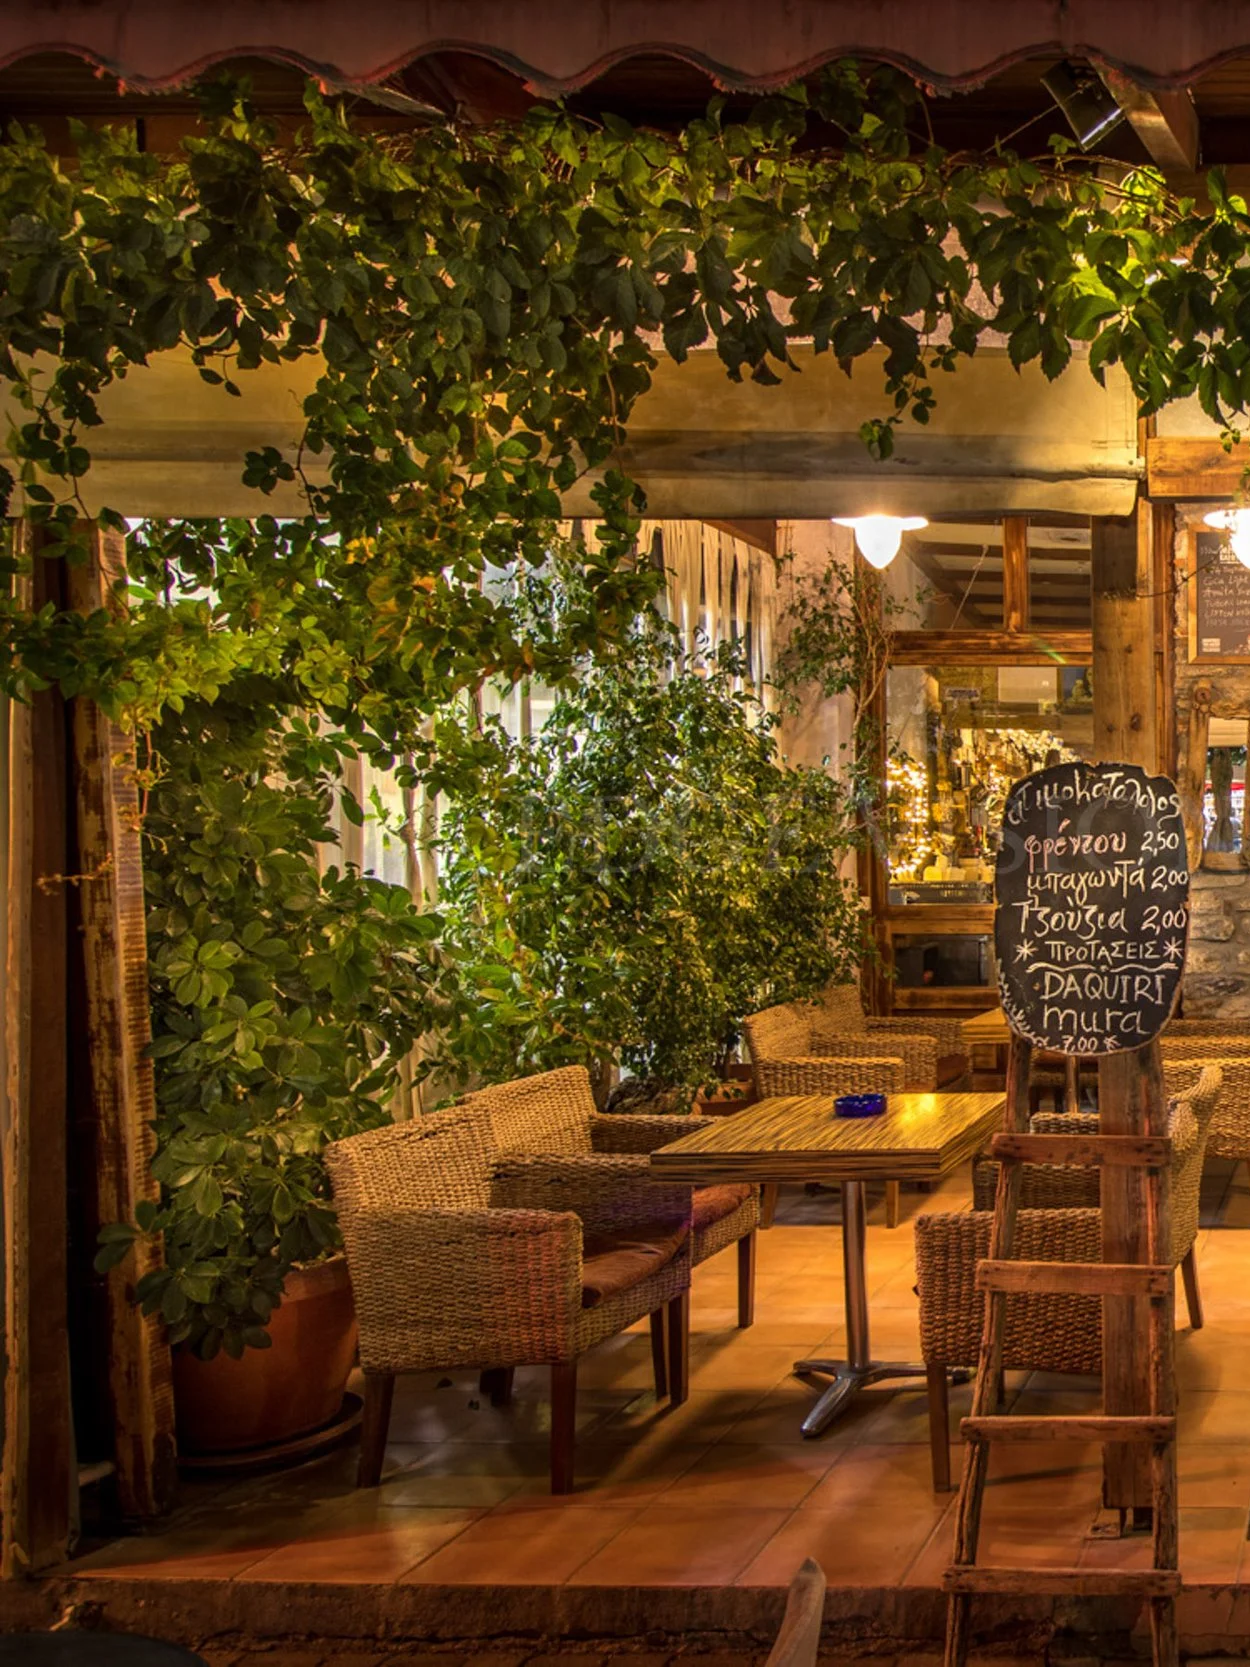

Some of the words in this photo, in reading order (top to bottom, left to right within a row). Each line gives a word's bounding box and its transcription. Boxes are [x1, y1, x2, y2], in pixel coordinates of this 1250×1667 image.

[1141, 831, 1179, 856] 2,50
[1151, 866, 1188, 892] 2,00
[1140, 905, 1188, 936] 2,00
[1044, 940, 1161, 965] ΠΡΟΤΑΣΕΙΣ
[1040, 971, 1166, 1005] DAQUIRI
[1043, 1004, 1151, 1037] mura
